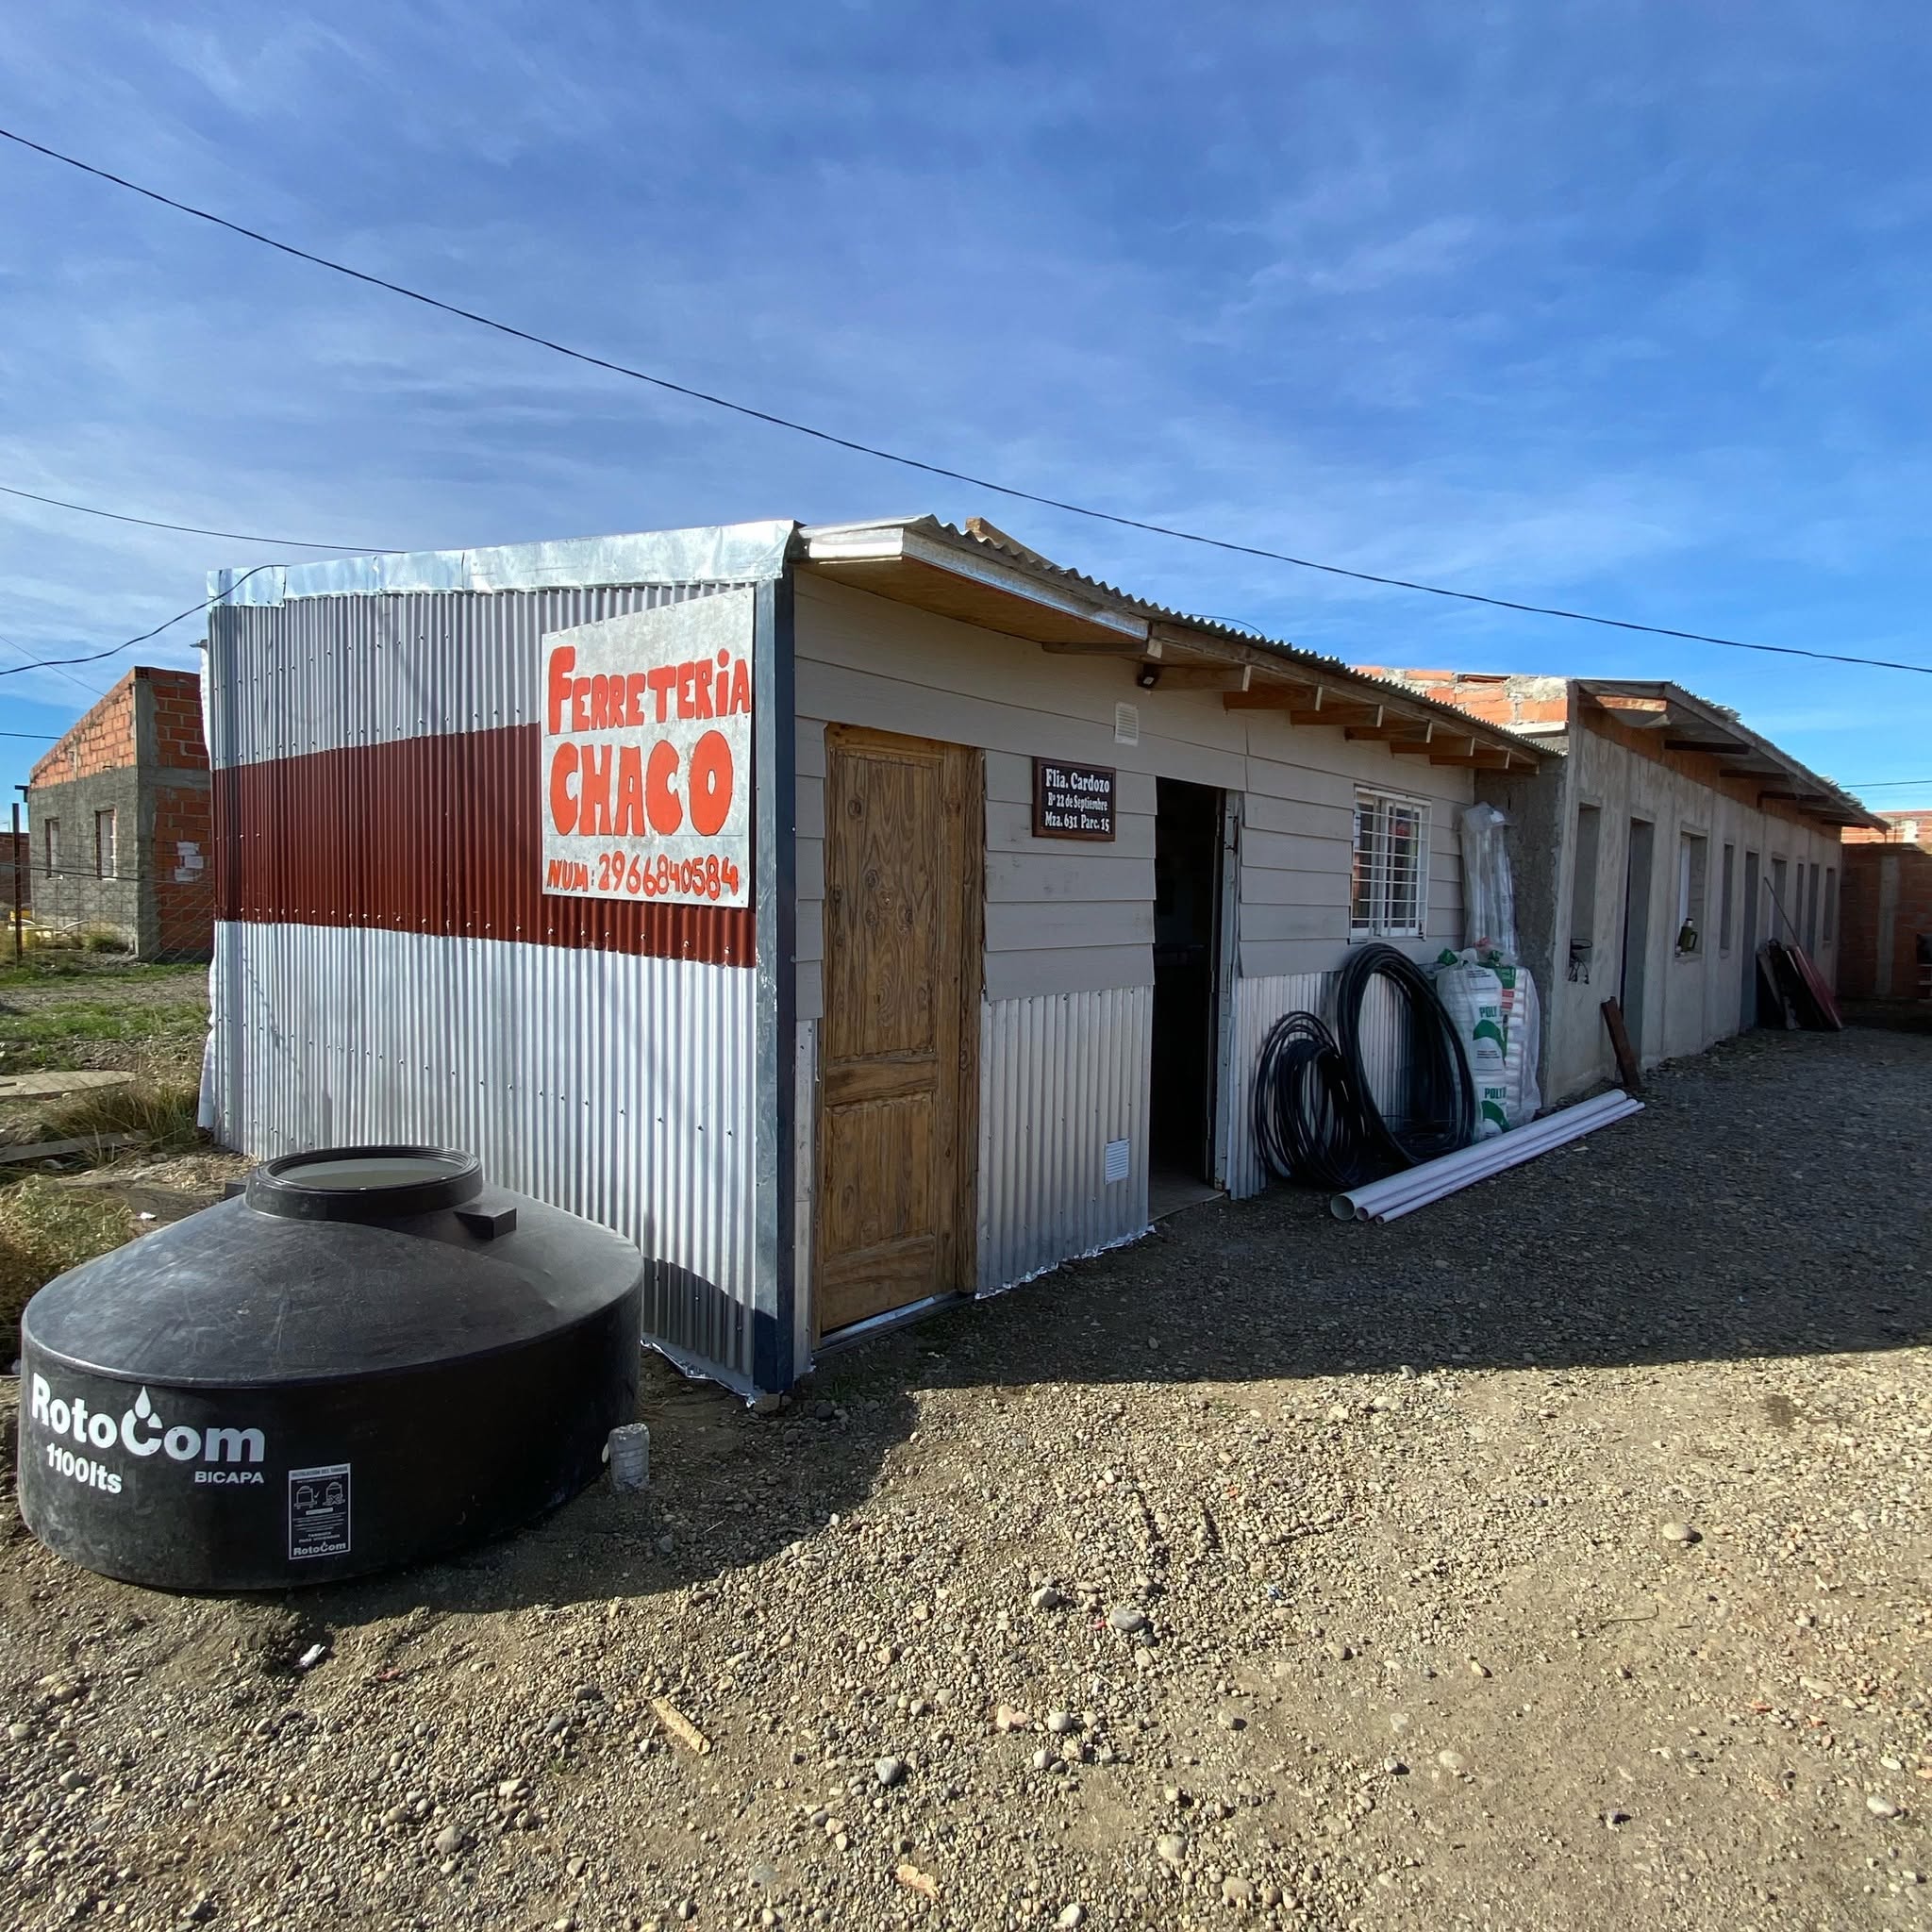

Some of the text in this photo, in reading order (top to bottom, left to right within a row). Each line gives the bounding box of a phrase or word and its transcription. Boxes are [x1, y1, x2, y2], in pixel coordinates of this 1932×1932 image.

[549, 729, 734, 837] CHACO
[1045, 768, 1109, 792] Flia. Cardozo
[1057, 793, 1064, 808] 22
[1065, 793, 1073, 808] de
[1074, 794, 1108, 811] Septiembre
[1045, 811, 1109, 832] Mza. 631 Parc. 15
[598, 850, 739, 901] 2966840584
[31, 1373, 266, 1462] RotoCom
[47, 1442, 123, 1494] 1100lts
[194, 1471, 264, 1484] BICAPA
[293, 1541, 347, 1557] RotoCom
